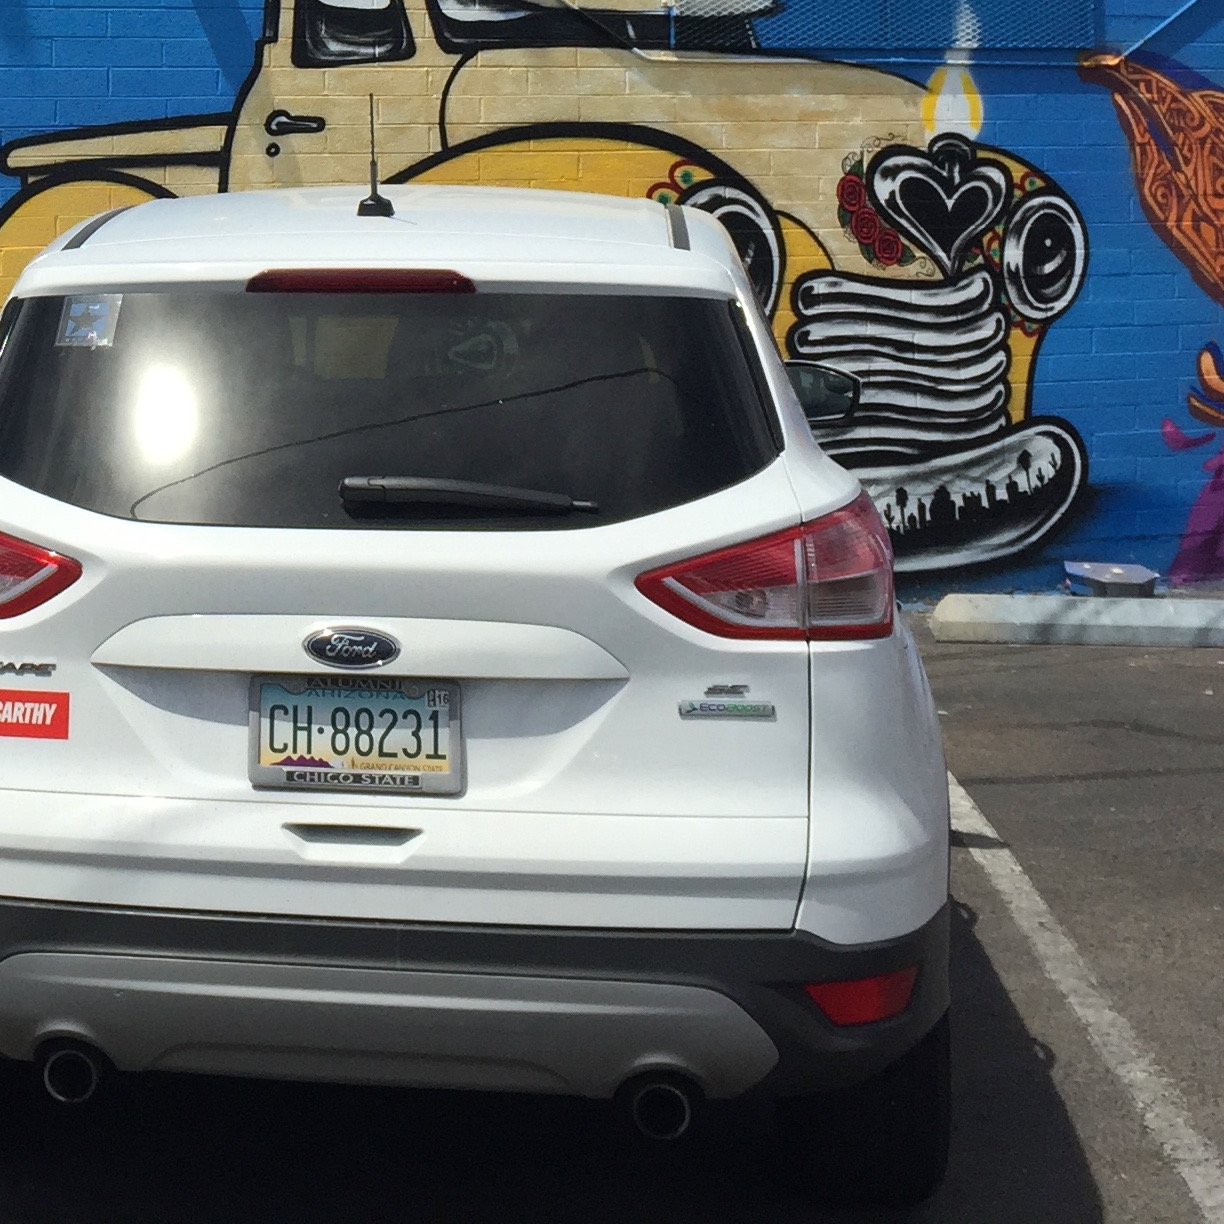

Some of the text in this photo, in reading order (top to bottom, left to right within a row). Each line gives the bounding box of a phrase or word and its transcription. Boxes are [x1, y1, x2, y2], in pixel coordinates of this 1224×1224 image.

[326, 634, 378, 659] Ford
[309, 677, 403, 690] ALUMNI
[308, 687, 406, 700] ARIZONA
[437, 693, 449, 705] 16
[359, 762, 444, 773] GRAND CANYON STATE
[293, 771, 414, 787] CHICO STATE
